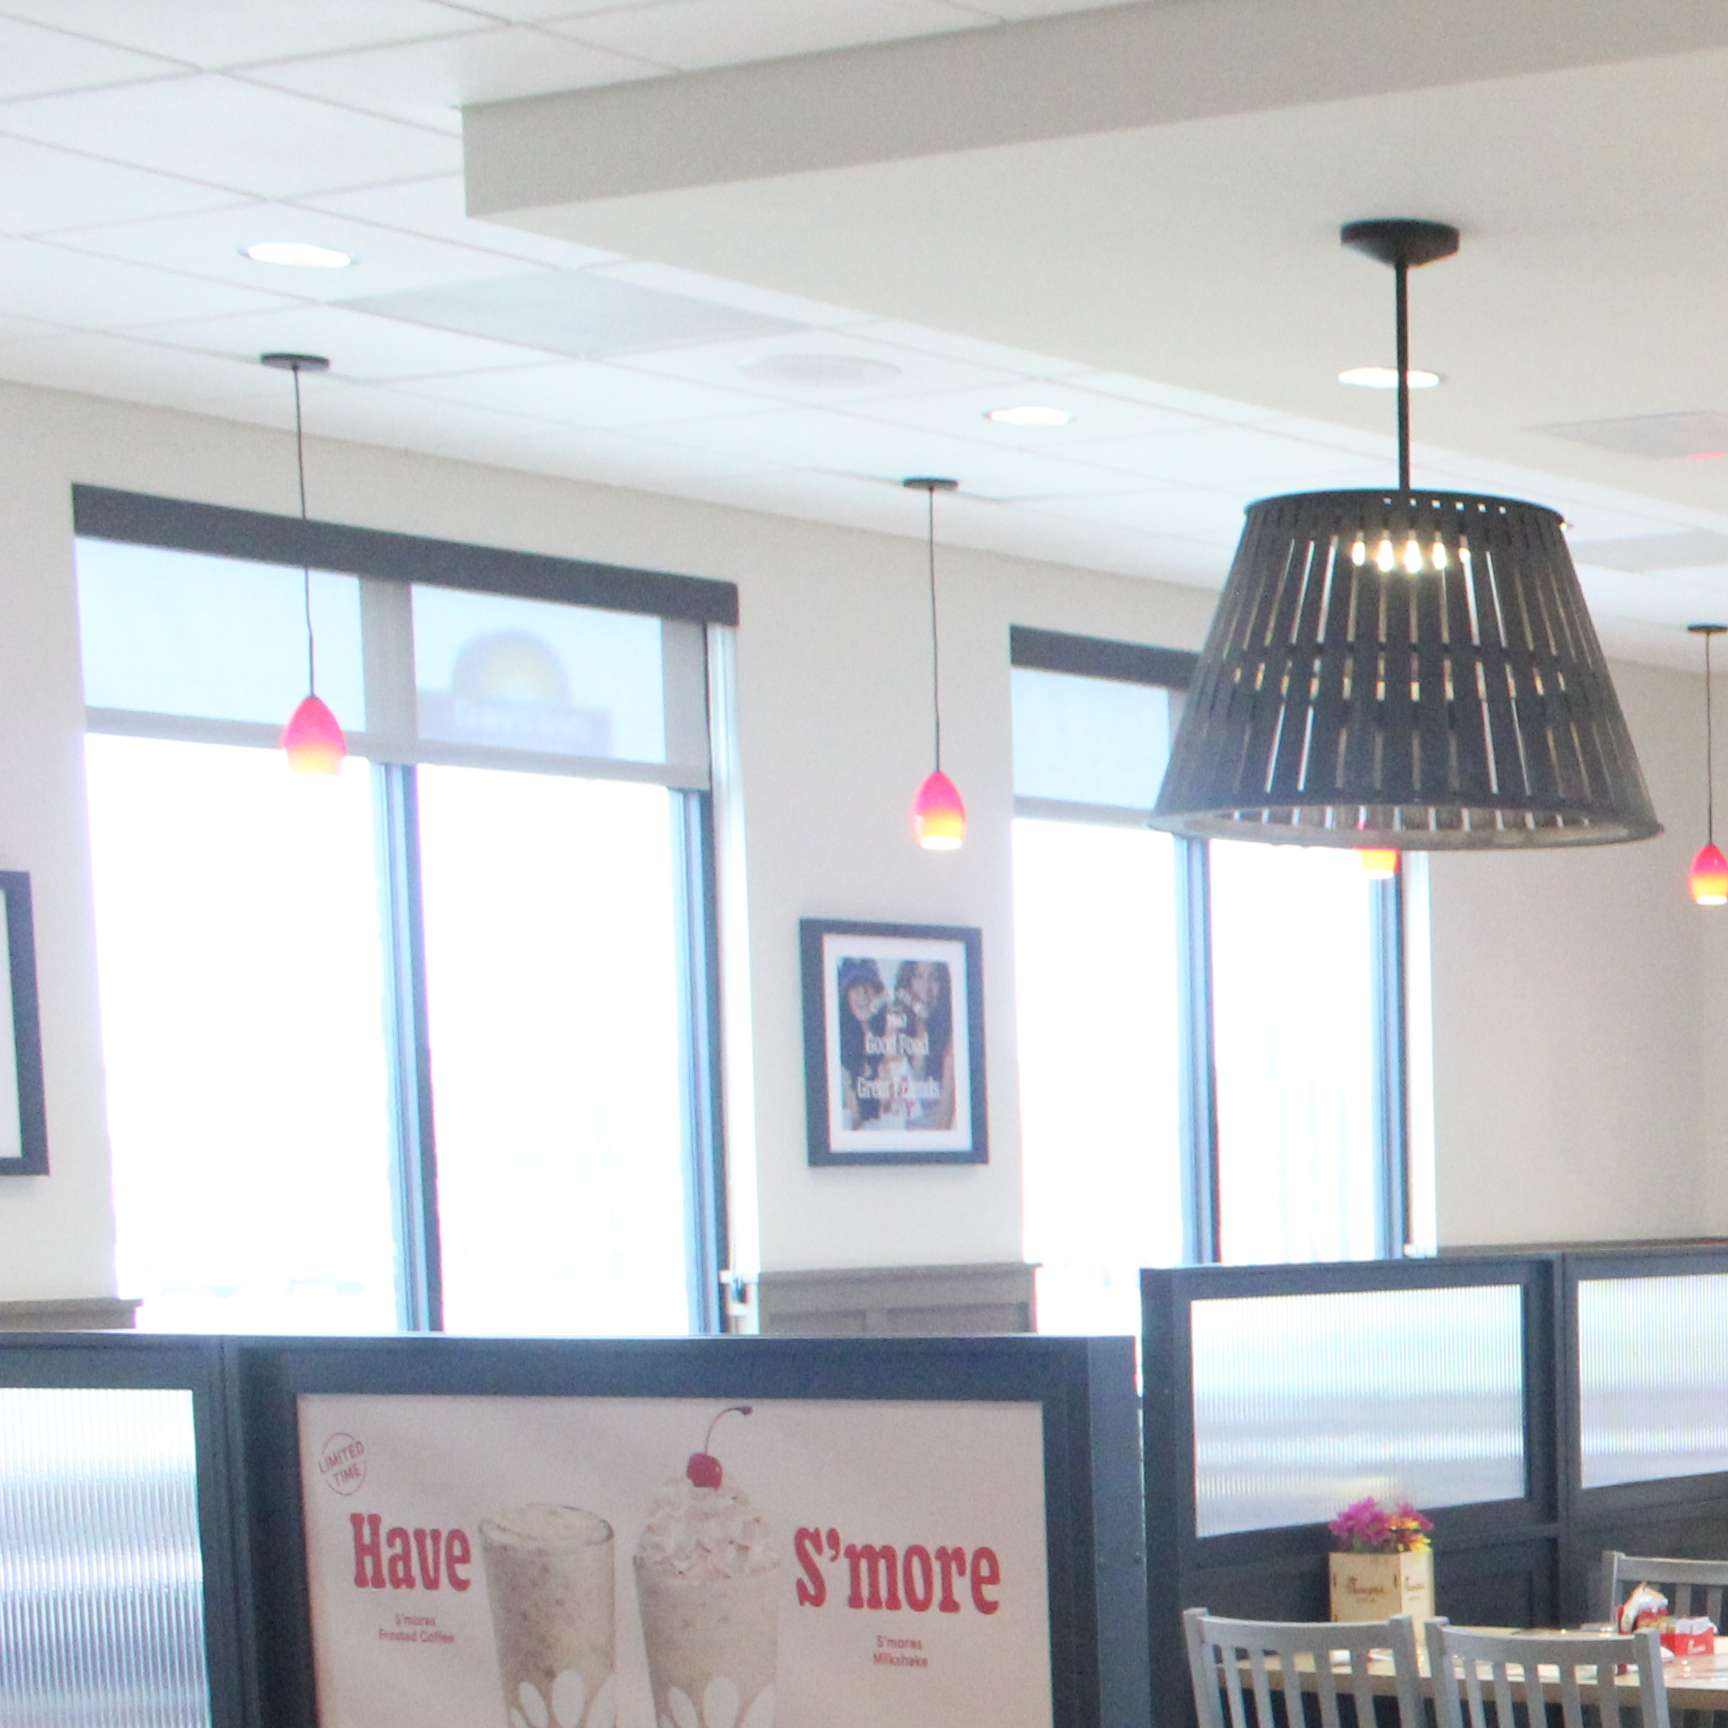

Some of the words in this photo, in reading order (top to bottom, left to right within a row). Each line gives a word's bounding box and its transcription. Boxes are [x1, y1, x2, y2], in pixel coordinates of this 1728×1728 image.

[318, 1441, 365, 1474] LIMITED
[333, 1463, 362, 1487] TIME
[350, 1512, 471, 1592] Have
[794, 1527, 1001, 1615] S'more
